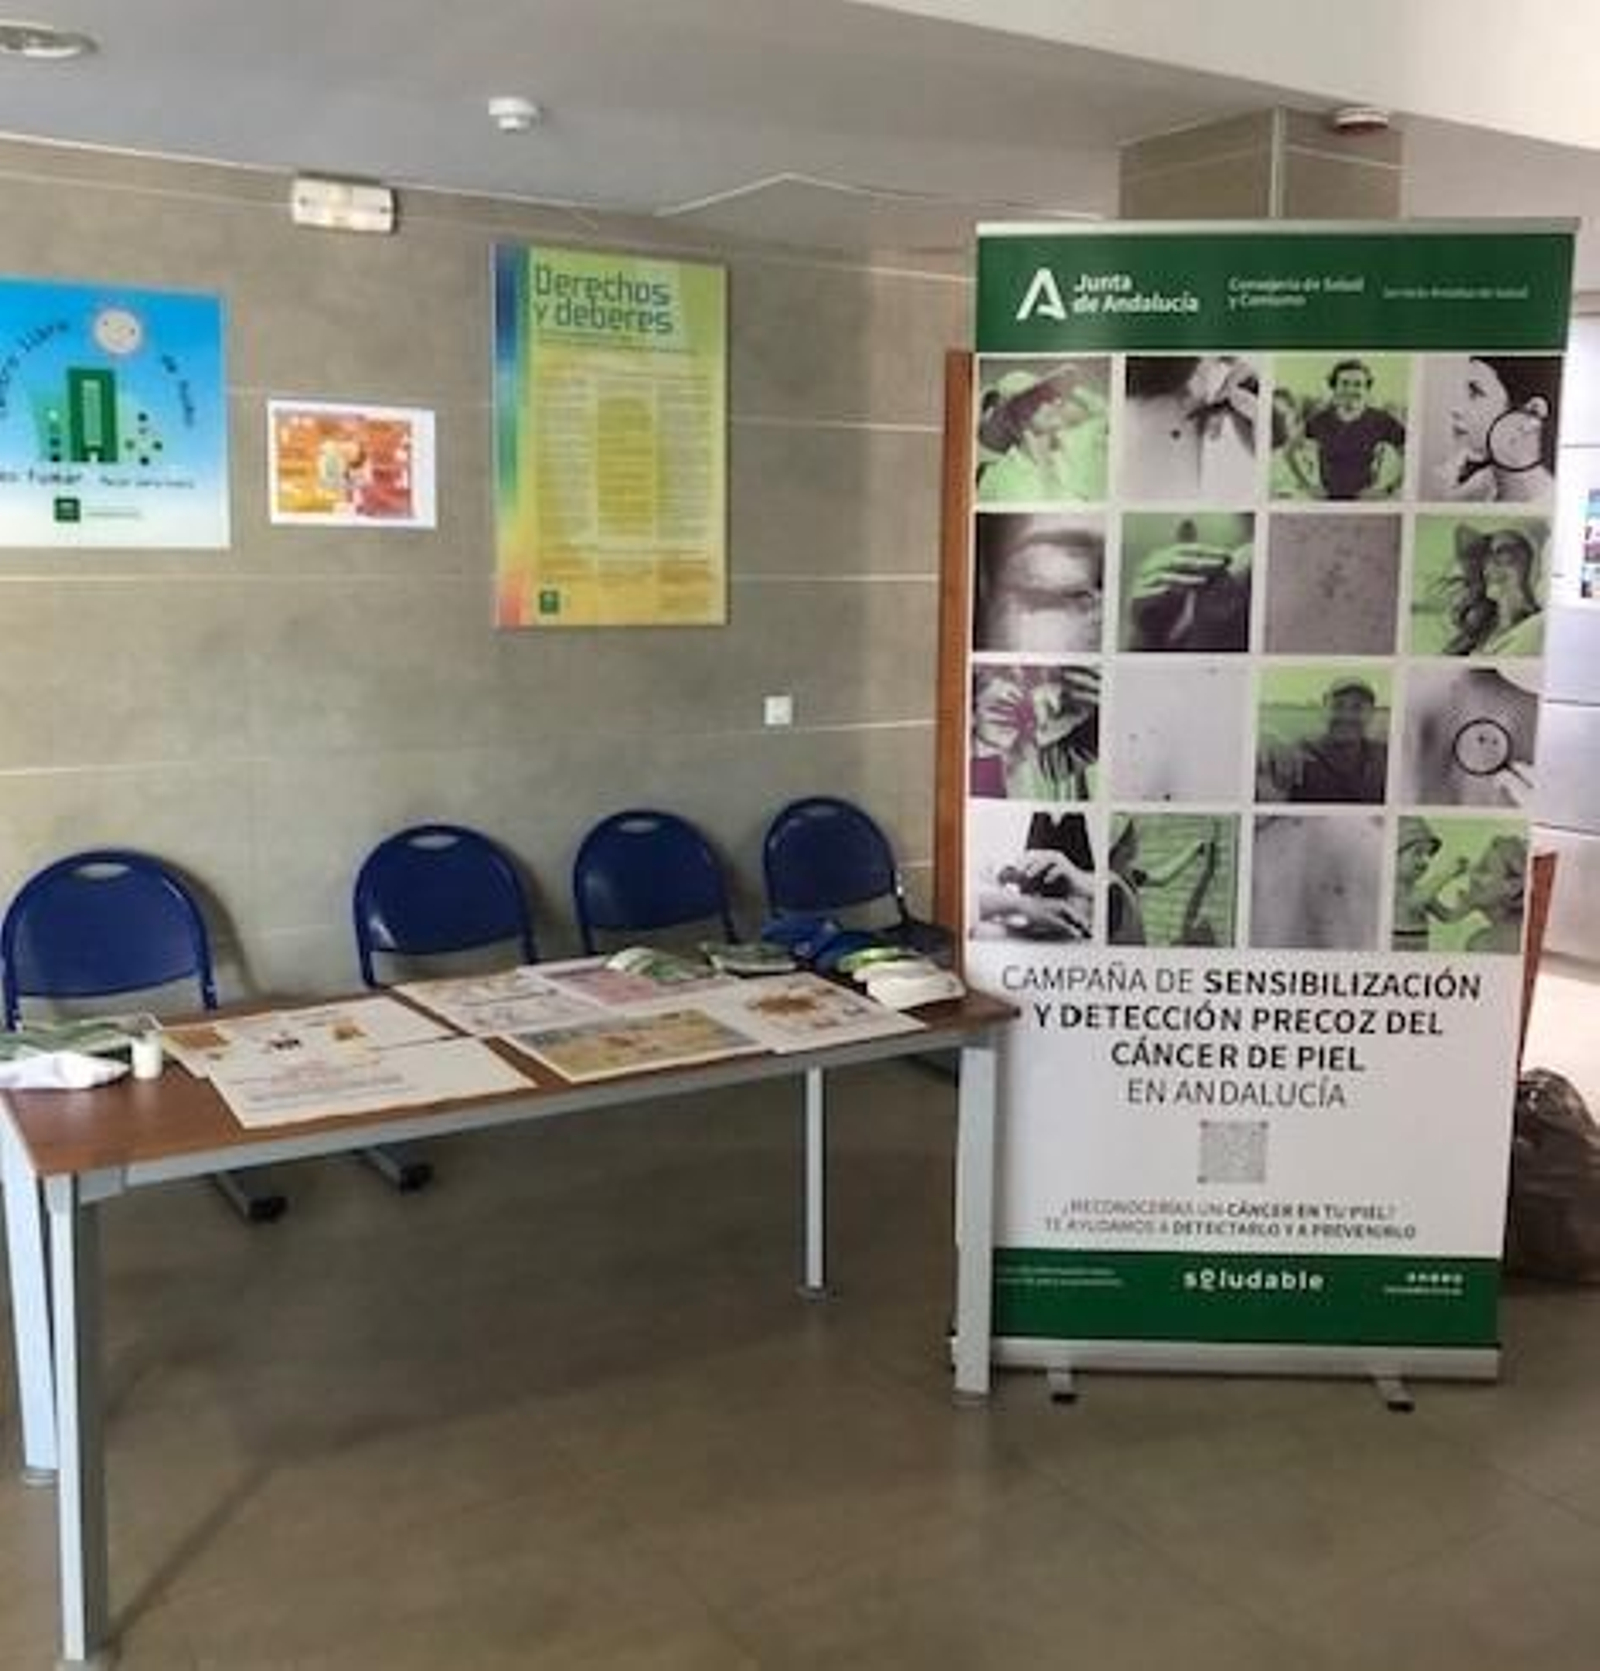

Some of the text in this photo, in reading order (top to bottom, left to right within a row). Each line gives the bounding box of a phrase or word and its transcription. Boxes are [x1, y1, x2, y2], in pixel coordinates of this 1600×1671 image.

[535, 264, 671, 306] Derechos
[1073, 273, 1132, 292] Junta
[534, 298, 673, 334] y deberes
[1073, 291, 1198, 312] de Andalucía
[1002, 962, 1481, 1000] CAMPAÑA DE SENSIBILIZACIÓN
[1034, 1000, 1443, 1035] Y DETECCIÓN PRECOZ DEL
[1111, 1036, 1366, 1072] CÁNCER DE PIEL
[1128, 1075, 1346, 1108] EN ANDALUCÍA
[1227, 1200, 1293, 1218] CÁNCER
[1298, 1203, 1320, 1218] EN
[1324, 1204, 1345, 1219] TU
[1172, 1219, 1280, 1237] DETECTARLO
